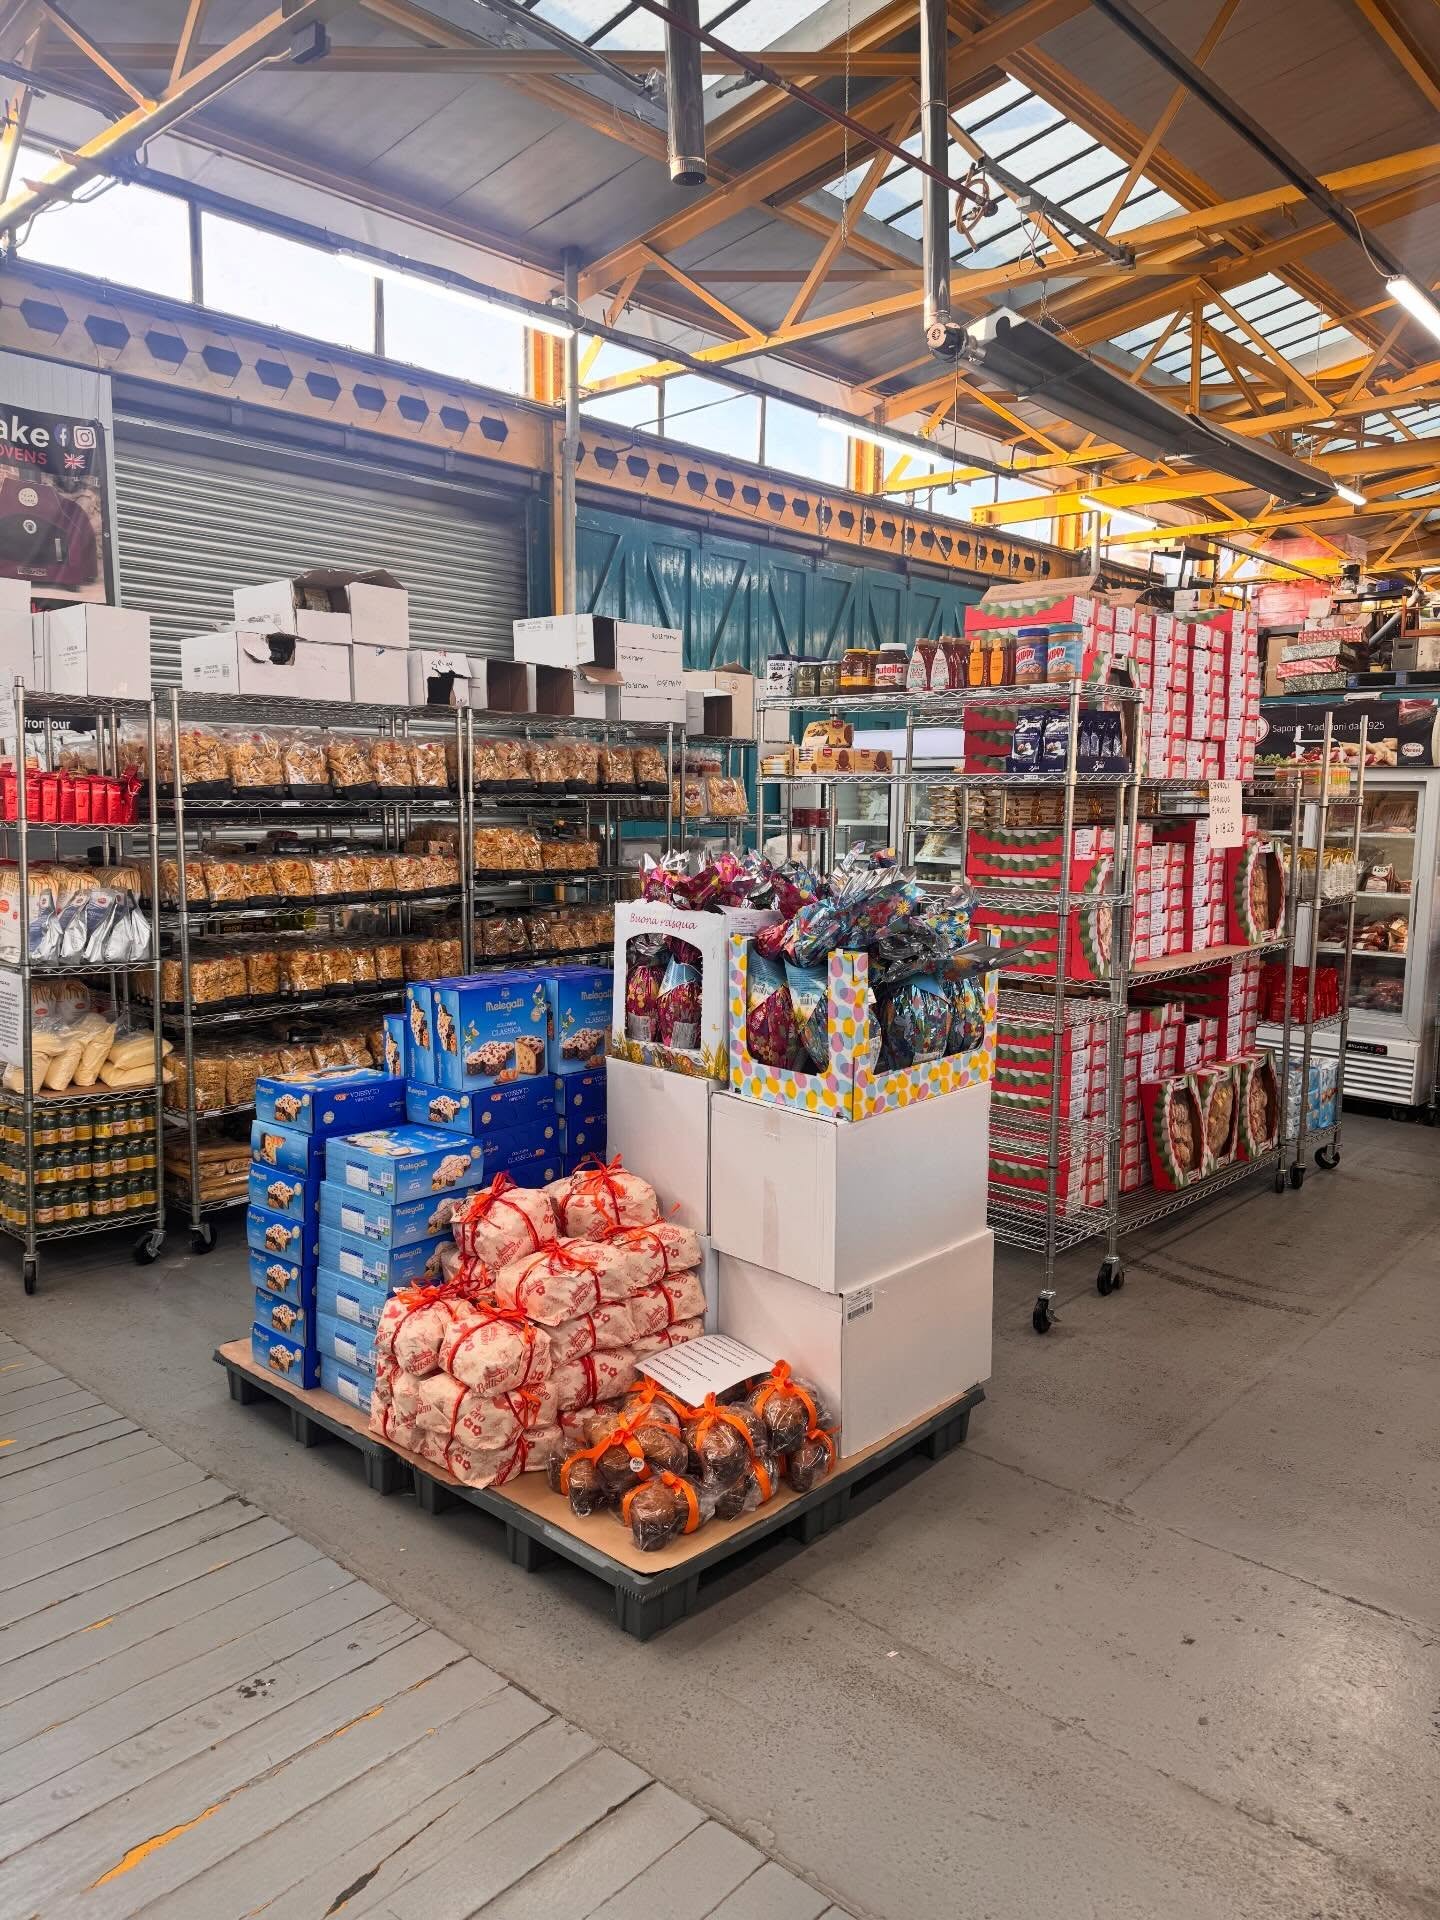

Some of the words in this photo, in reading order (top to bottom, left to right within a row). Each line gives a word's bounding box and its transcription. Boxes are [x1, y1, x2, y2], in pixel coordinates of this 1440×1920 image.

[51, 720, 71, 730] our
[1349, 722, 1361, 731] da
[1365, 721, 1385, 730] 925
[629, 912, 661, 926] Buona
[485, 998, 524, 1013] Melegatti
[491, 1027, 522, 1038] CLASSICA
